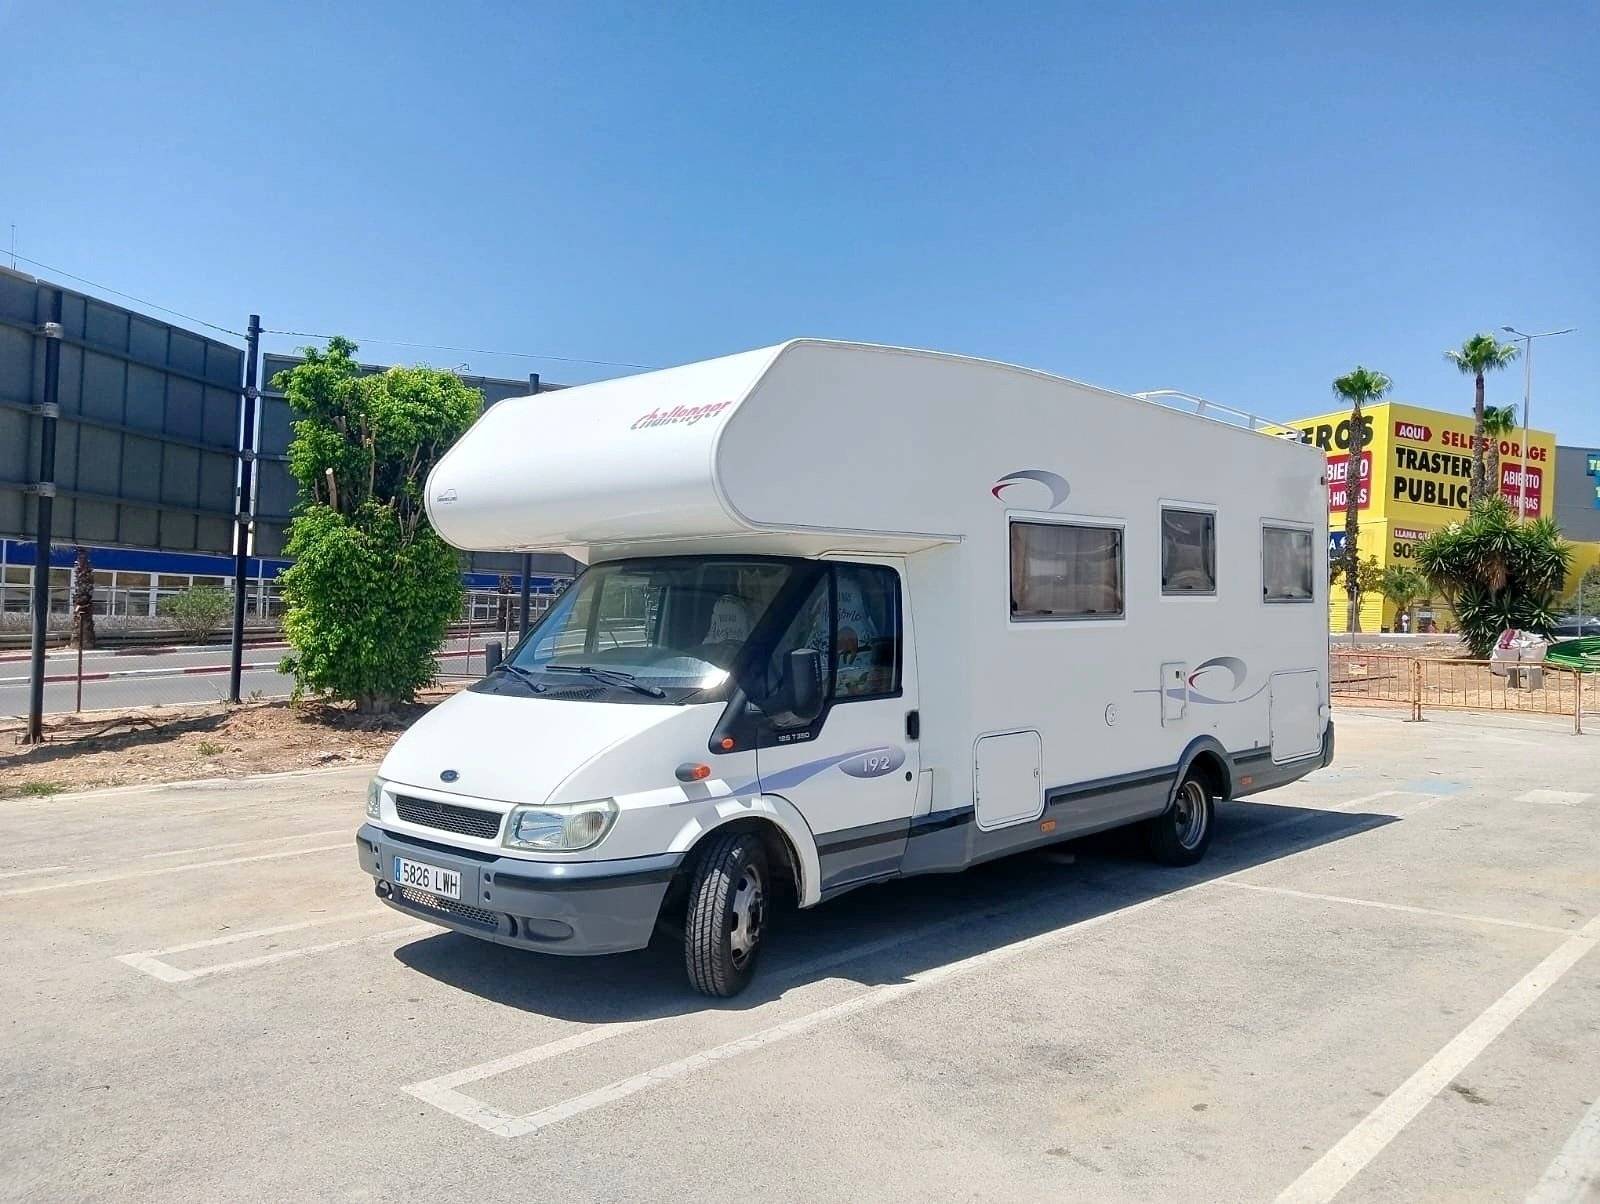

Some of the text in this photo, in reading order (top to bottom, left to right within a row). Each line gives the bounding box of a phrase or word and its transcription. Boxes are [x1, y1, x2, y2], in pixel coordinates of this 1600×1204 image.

[1399, 424, 1425, 440] AQUÍ
[1395, 447, 1474, 479] TRASTER
[1480, 437, 1547, 462] SORAGE
[1393, 476, 1472, 508] PUBLIC
[863, 757, 889, 772] 192
[403, 863, 457, 895] 5826 LWH
